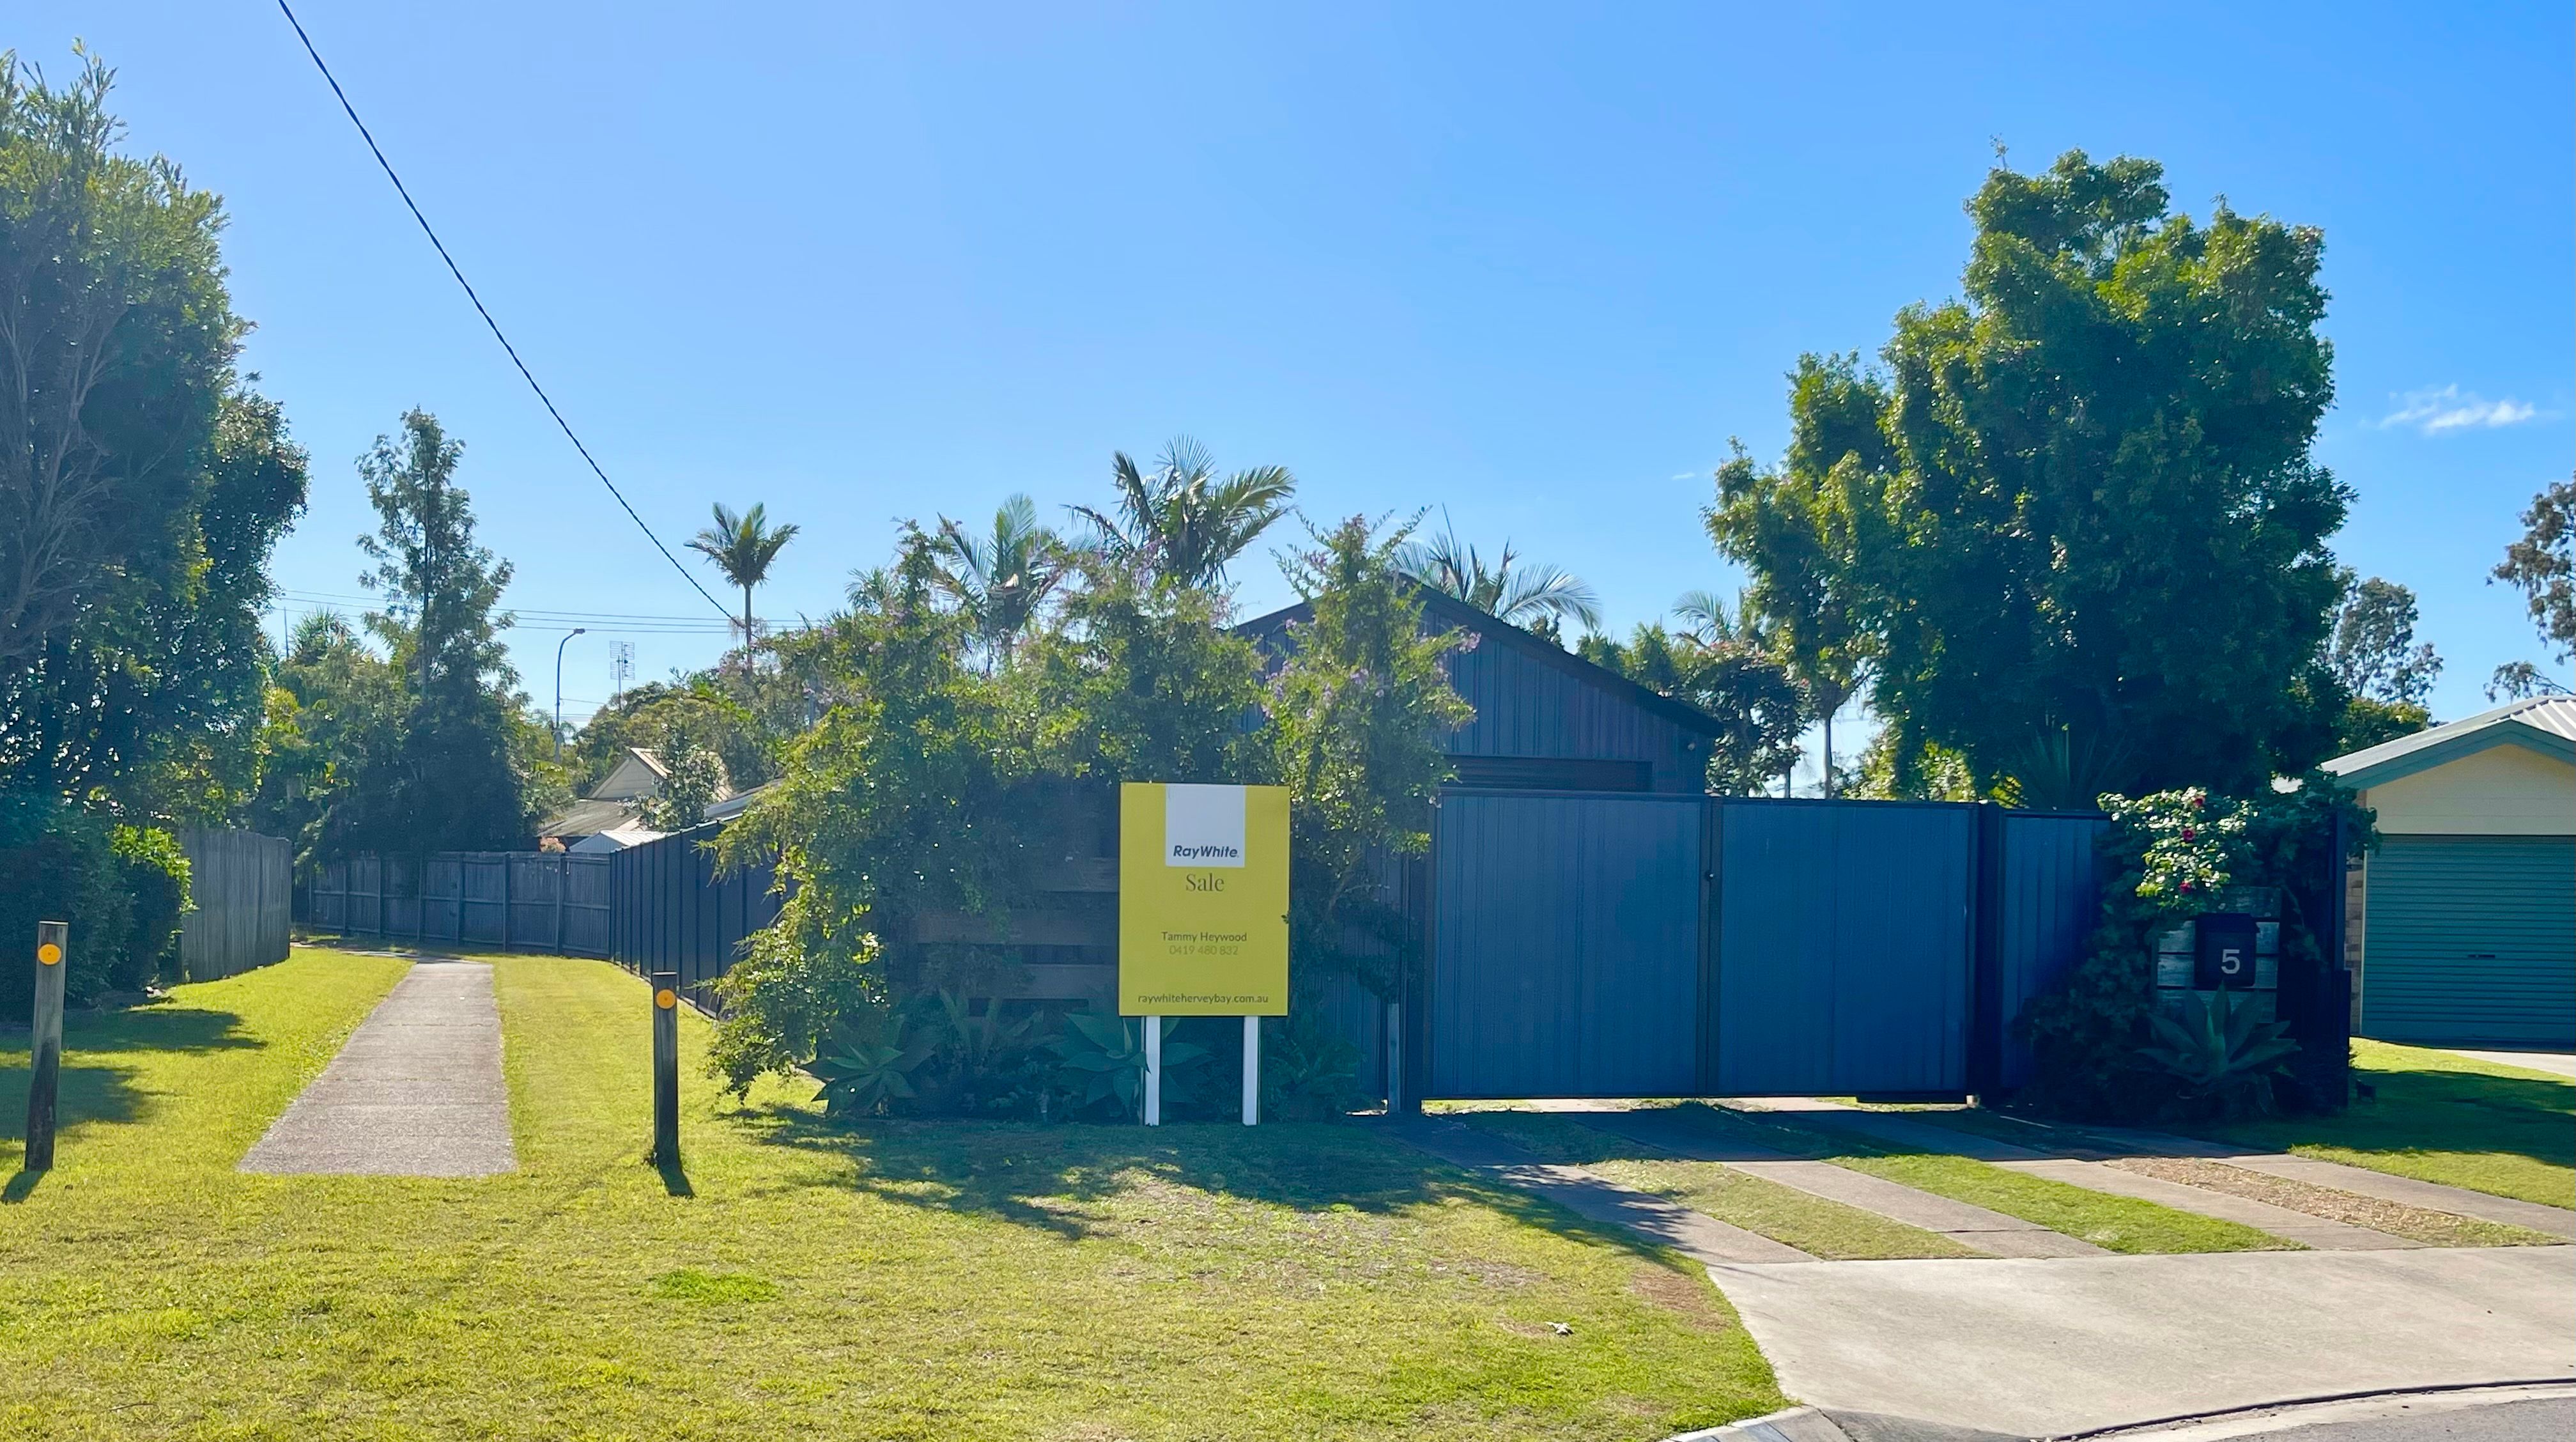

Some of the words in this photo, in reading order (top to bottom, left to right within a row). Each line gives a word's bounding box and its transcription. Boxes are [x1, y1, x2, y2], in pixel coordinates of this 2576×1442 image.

[1185, 872, 1224, 892] Sale
[1161, 931, 1198, 943] Tammy
[1200, 932, 1247, 943] Heywood
[1169, 945, 1195, 955] 0419
[1219, 945, 1238, 956] 832
[2221, 949, 2241, 974] 5
[1138, 993, 1269, 1004] raywhiteherveybay.com.au
